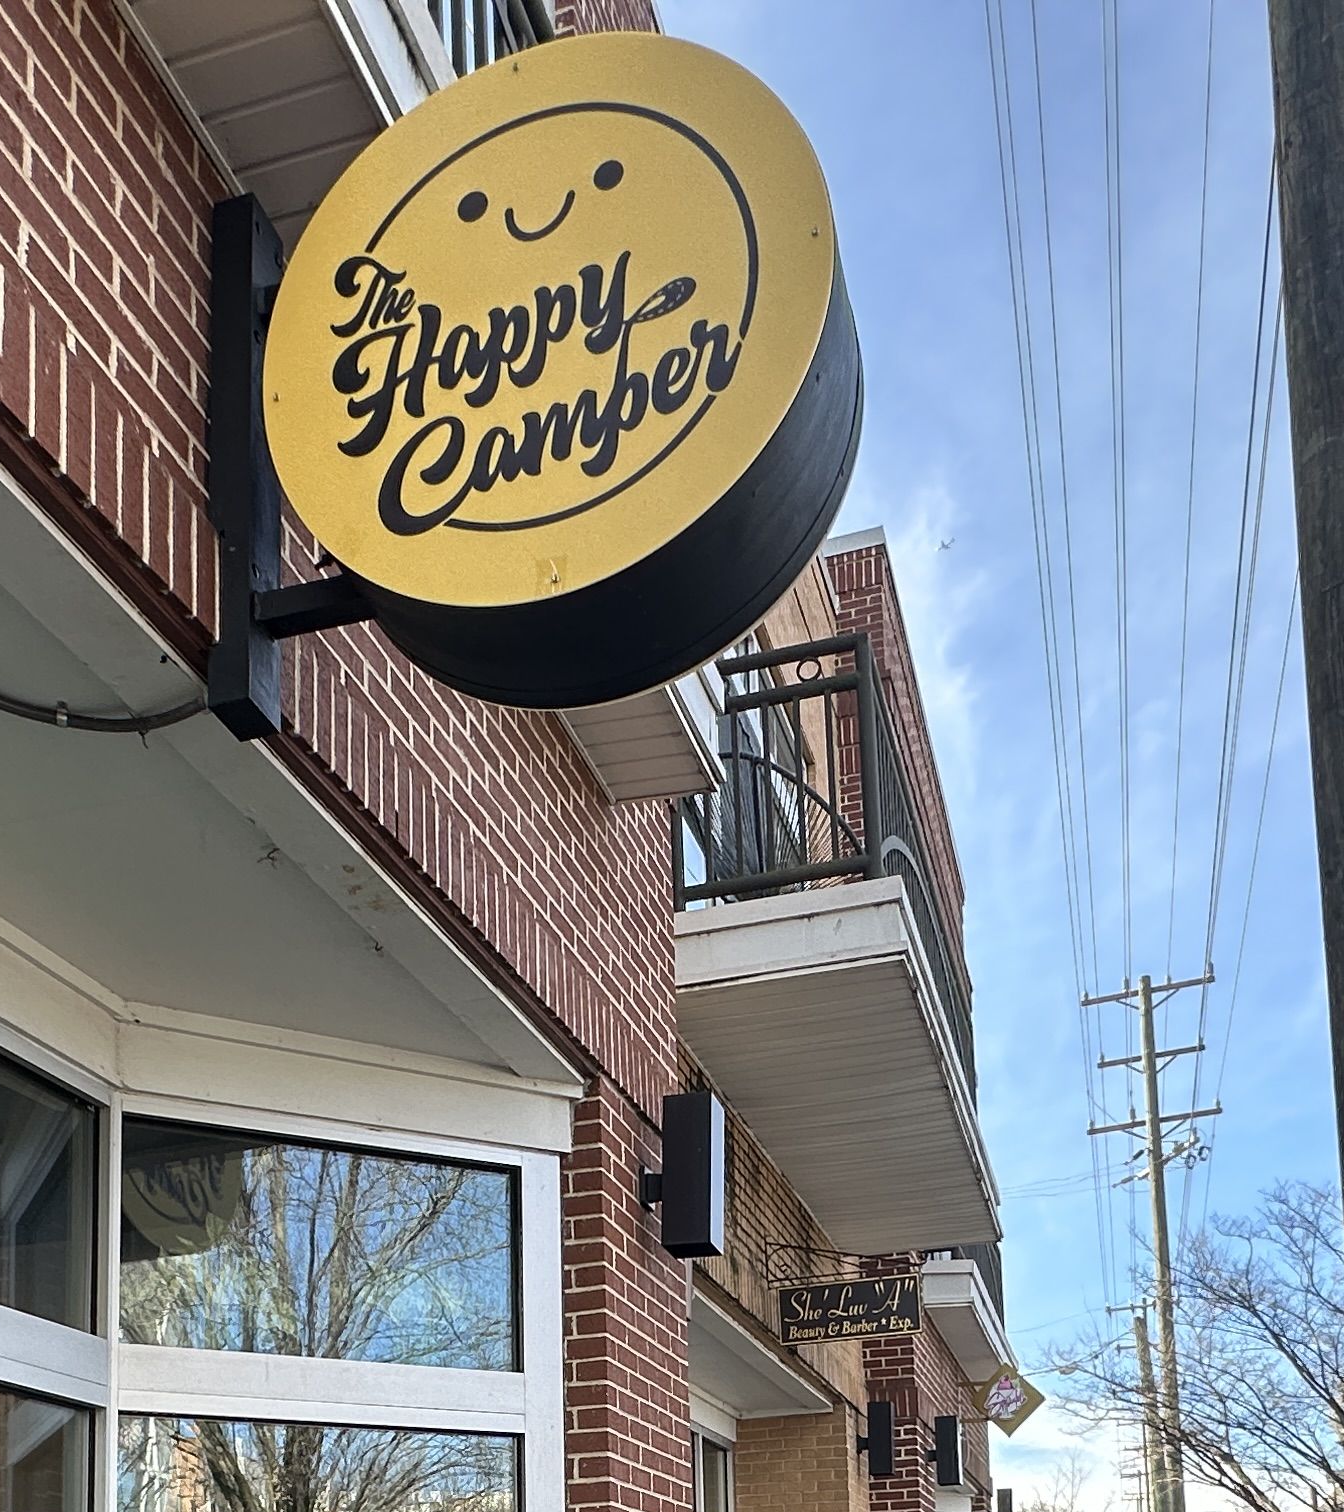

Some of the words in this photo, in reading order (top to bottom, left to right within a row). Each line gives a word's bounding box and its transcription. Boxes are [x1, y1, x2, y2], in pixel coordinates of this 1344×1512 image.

[330, 256, 415, 338] The
[332, 250, 631, 456] Happy
[377, 317, 741, 536] Camper
[788, 1325, 826, 1339] Beauty
[827, 1321, 839, 1336] &
[842, 1318, 878, 1334] Barber
[889, 1315, 914, 1332] Exp.
[828, 1285, 868, 1319] Luv
